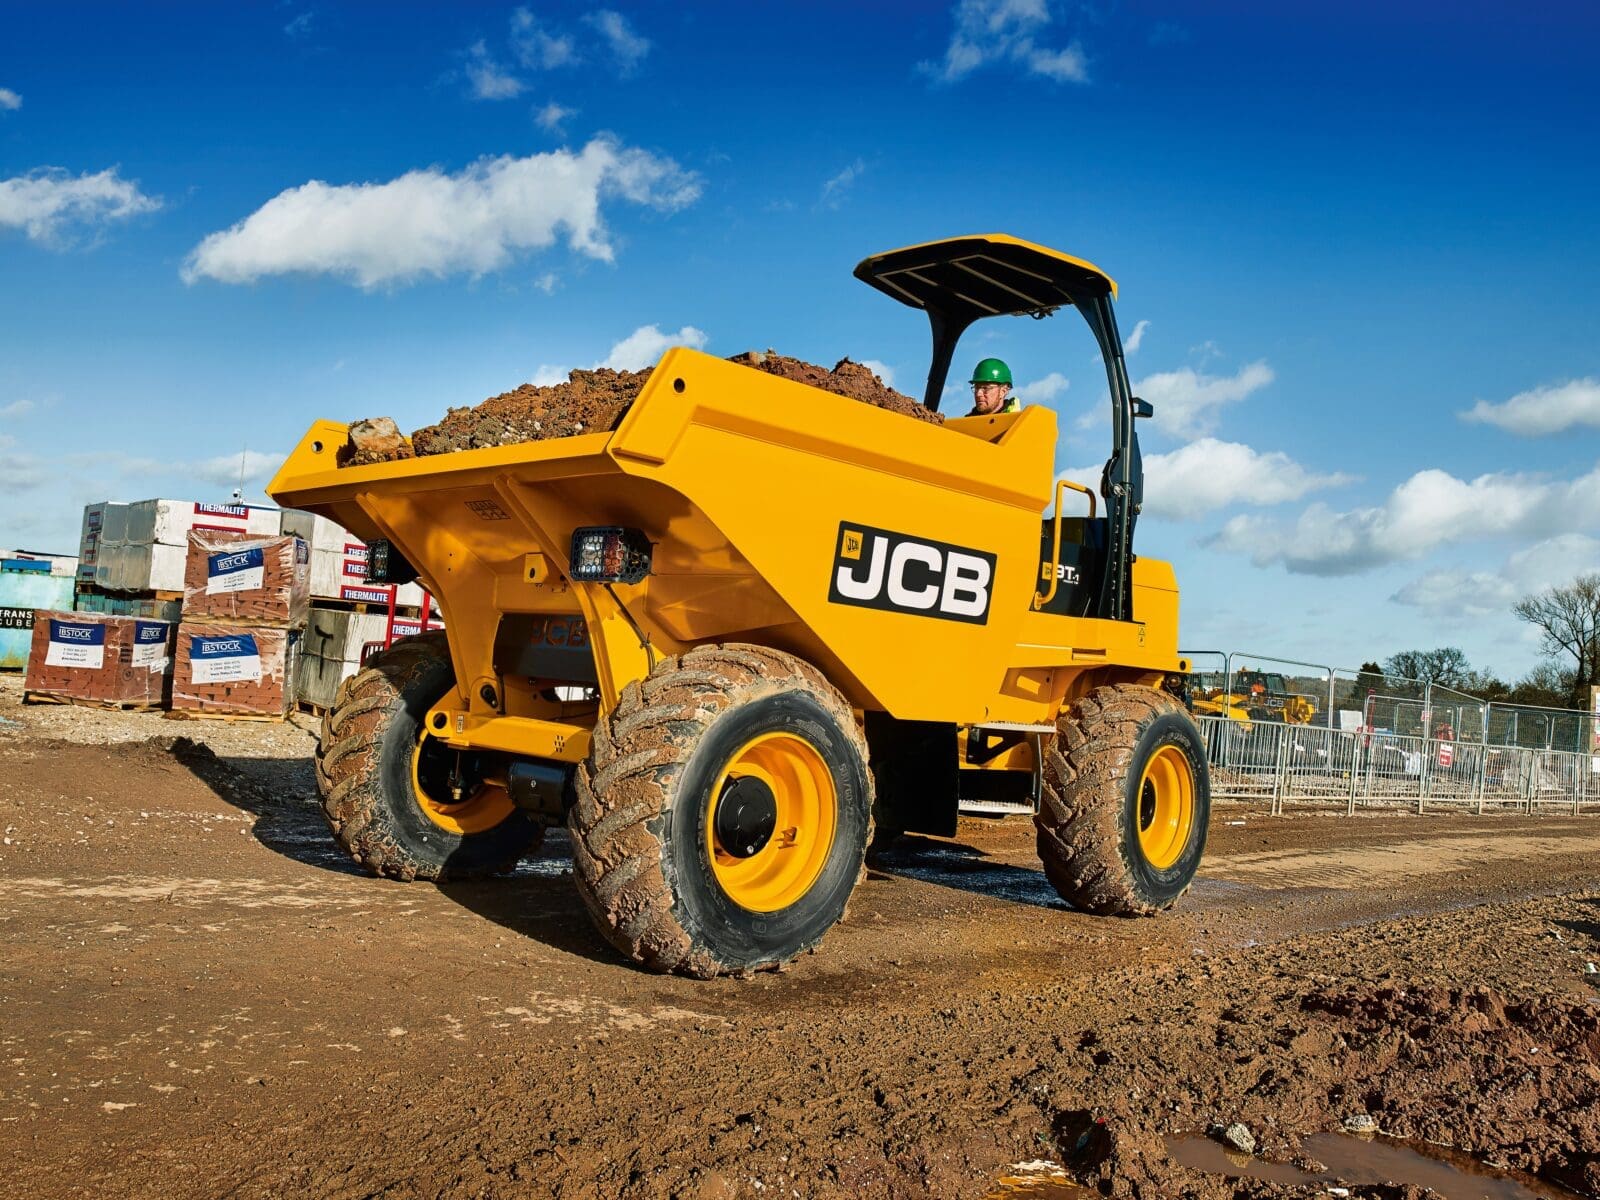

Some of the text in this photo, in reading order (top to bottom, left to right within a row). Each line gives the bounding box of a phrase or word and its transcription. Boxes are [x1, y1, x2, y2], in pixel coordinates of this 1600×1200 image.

[199, 503, 246, 516] THERMALITE
[836, 536, 991, 617] JCB
[344, 589, 389, 603] THERMALITE
[59, 627, 93, 639] IBSTOCK
[392, 624, 422, 636] THERMA
[202, 642, 242, 653] IBSTOCK
[1263, 699, 1284, 708] JCB
